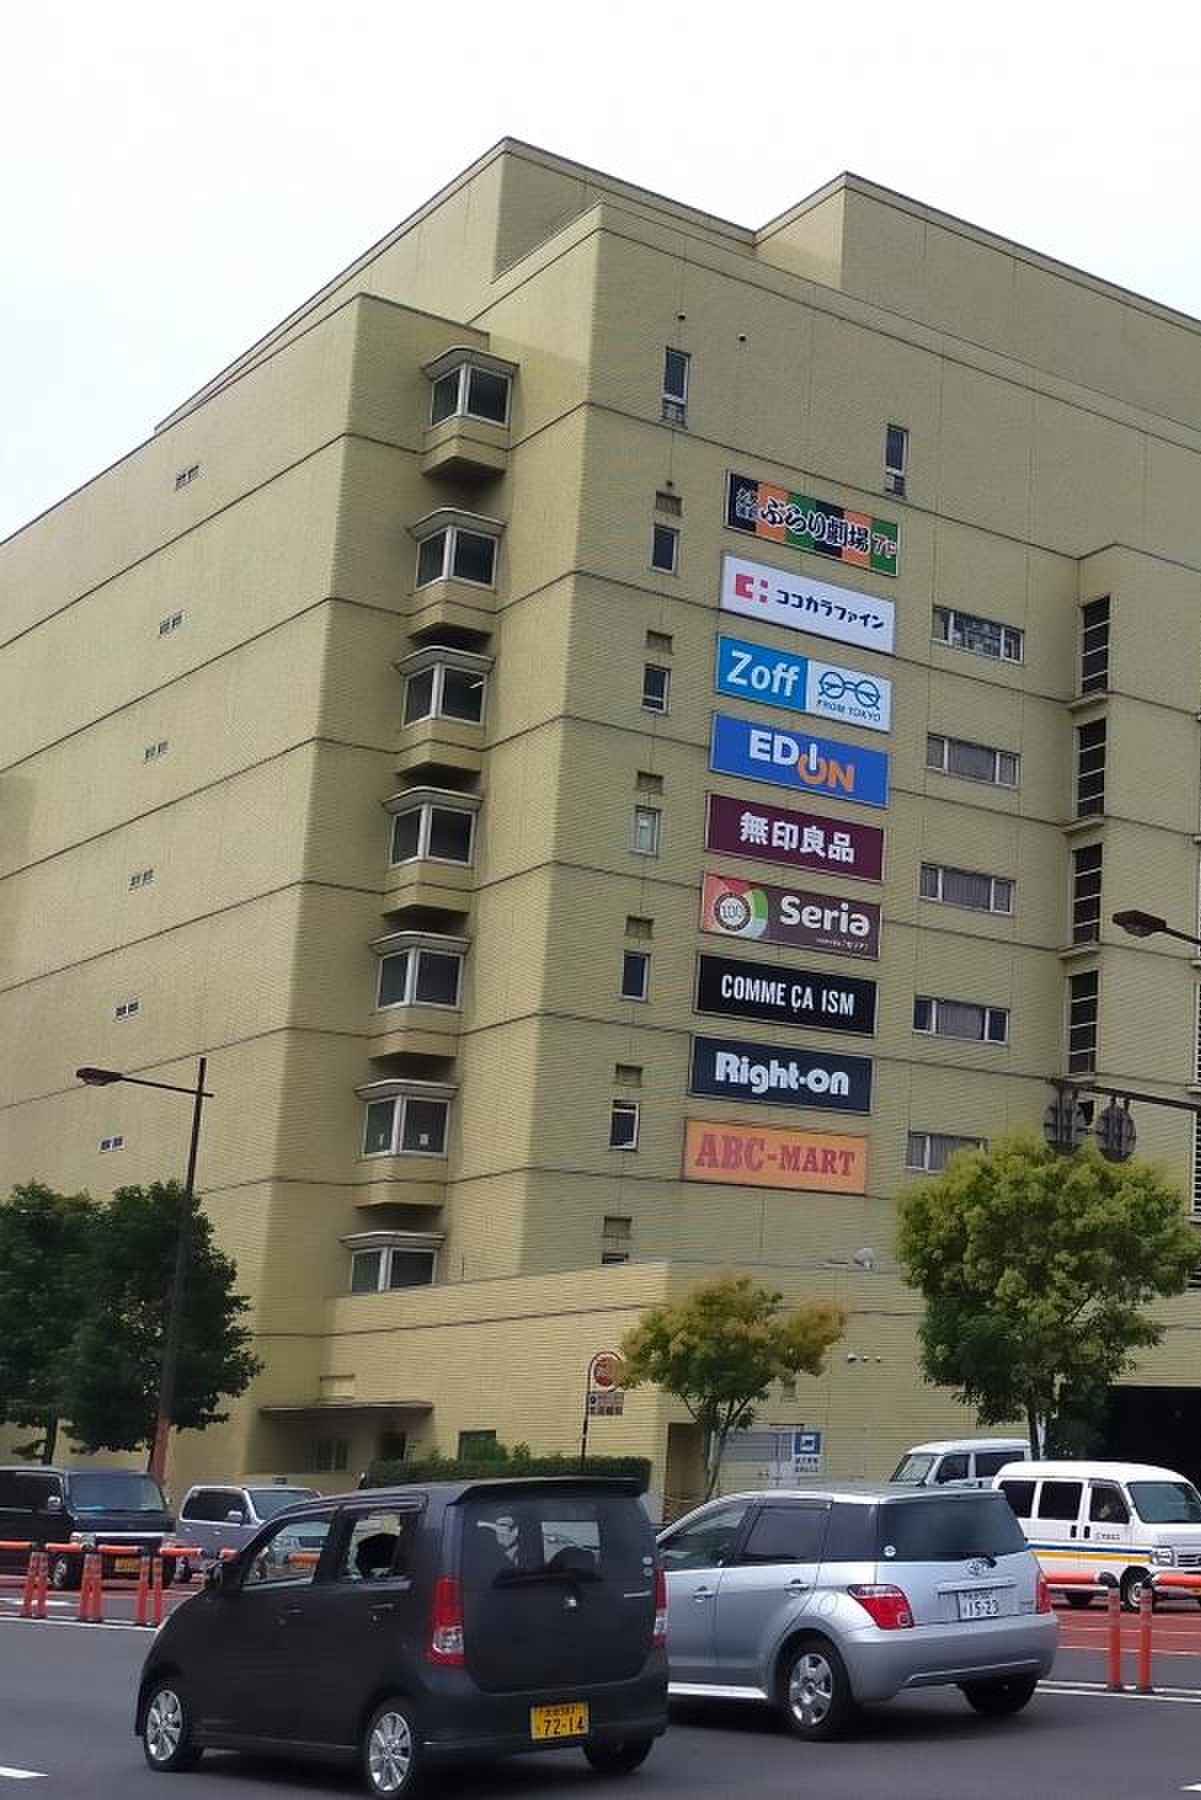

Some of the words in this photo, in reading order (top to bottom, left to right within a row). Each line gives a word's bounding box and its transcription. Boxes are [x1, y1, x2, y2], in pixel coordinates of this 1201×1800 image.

[759, 496, 870, 555] ぶらり劇場
[776, 589, 885, 630] ココカラファイン
[727, 650, 800, 697] Zoff
[816, 699, 846, 713] FROM
[848, 707, 881, 722] TOKYO
[749, 729, 855, 792] EDION
[740, 812, 855, 864] 無印良品
[780, 895, 870, 937] Seria
[721, 975, 786, 1008] COMME
[791, 980, 814, 1013] ÇA
[821, 983, 855, 1016] ISM
[715, 1051, 849, 1095] Right-on
[695, 1133, 856, 1177] ABC-MART
[544, 1716, 585, 1736] 72-14
